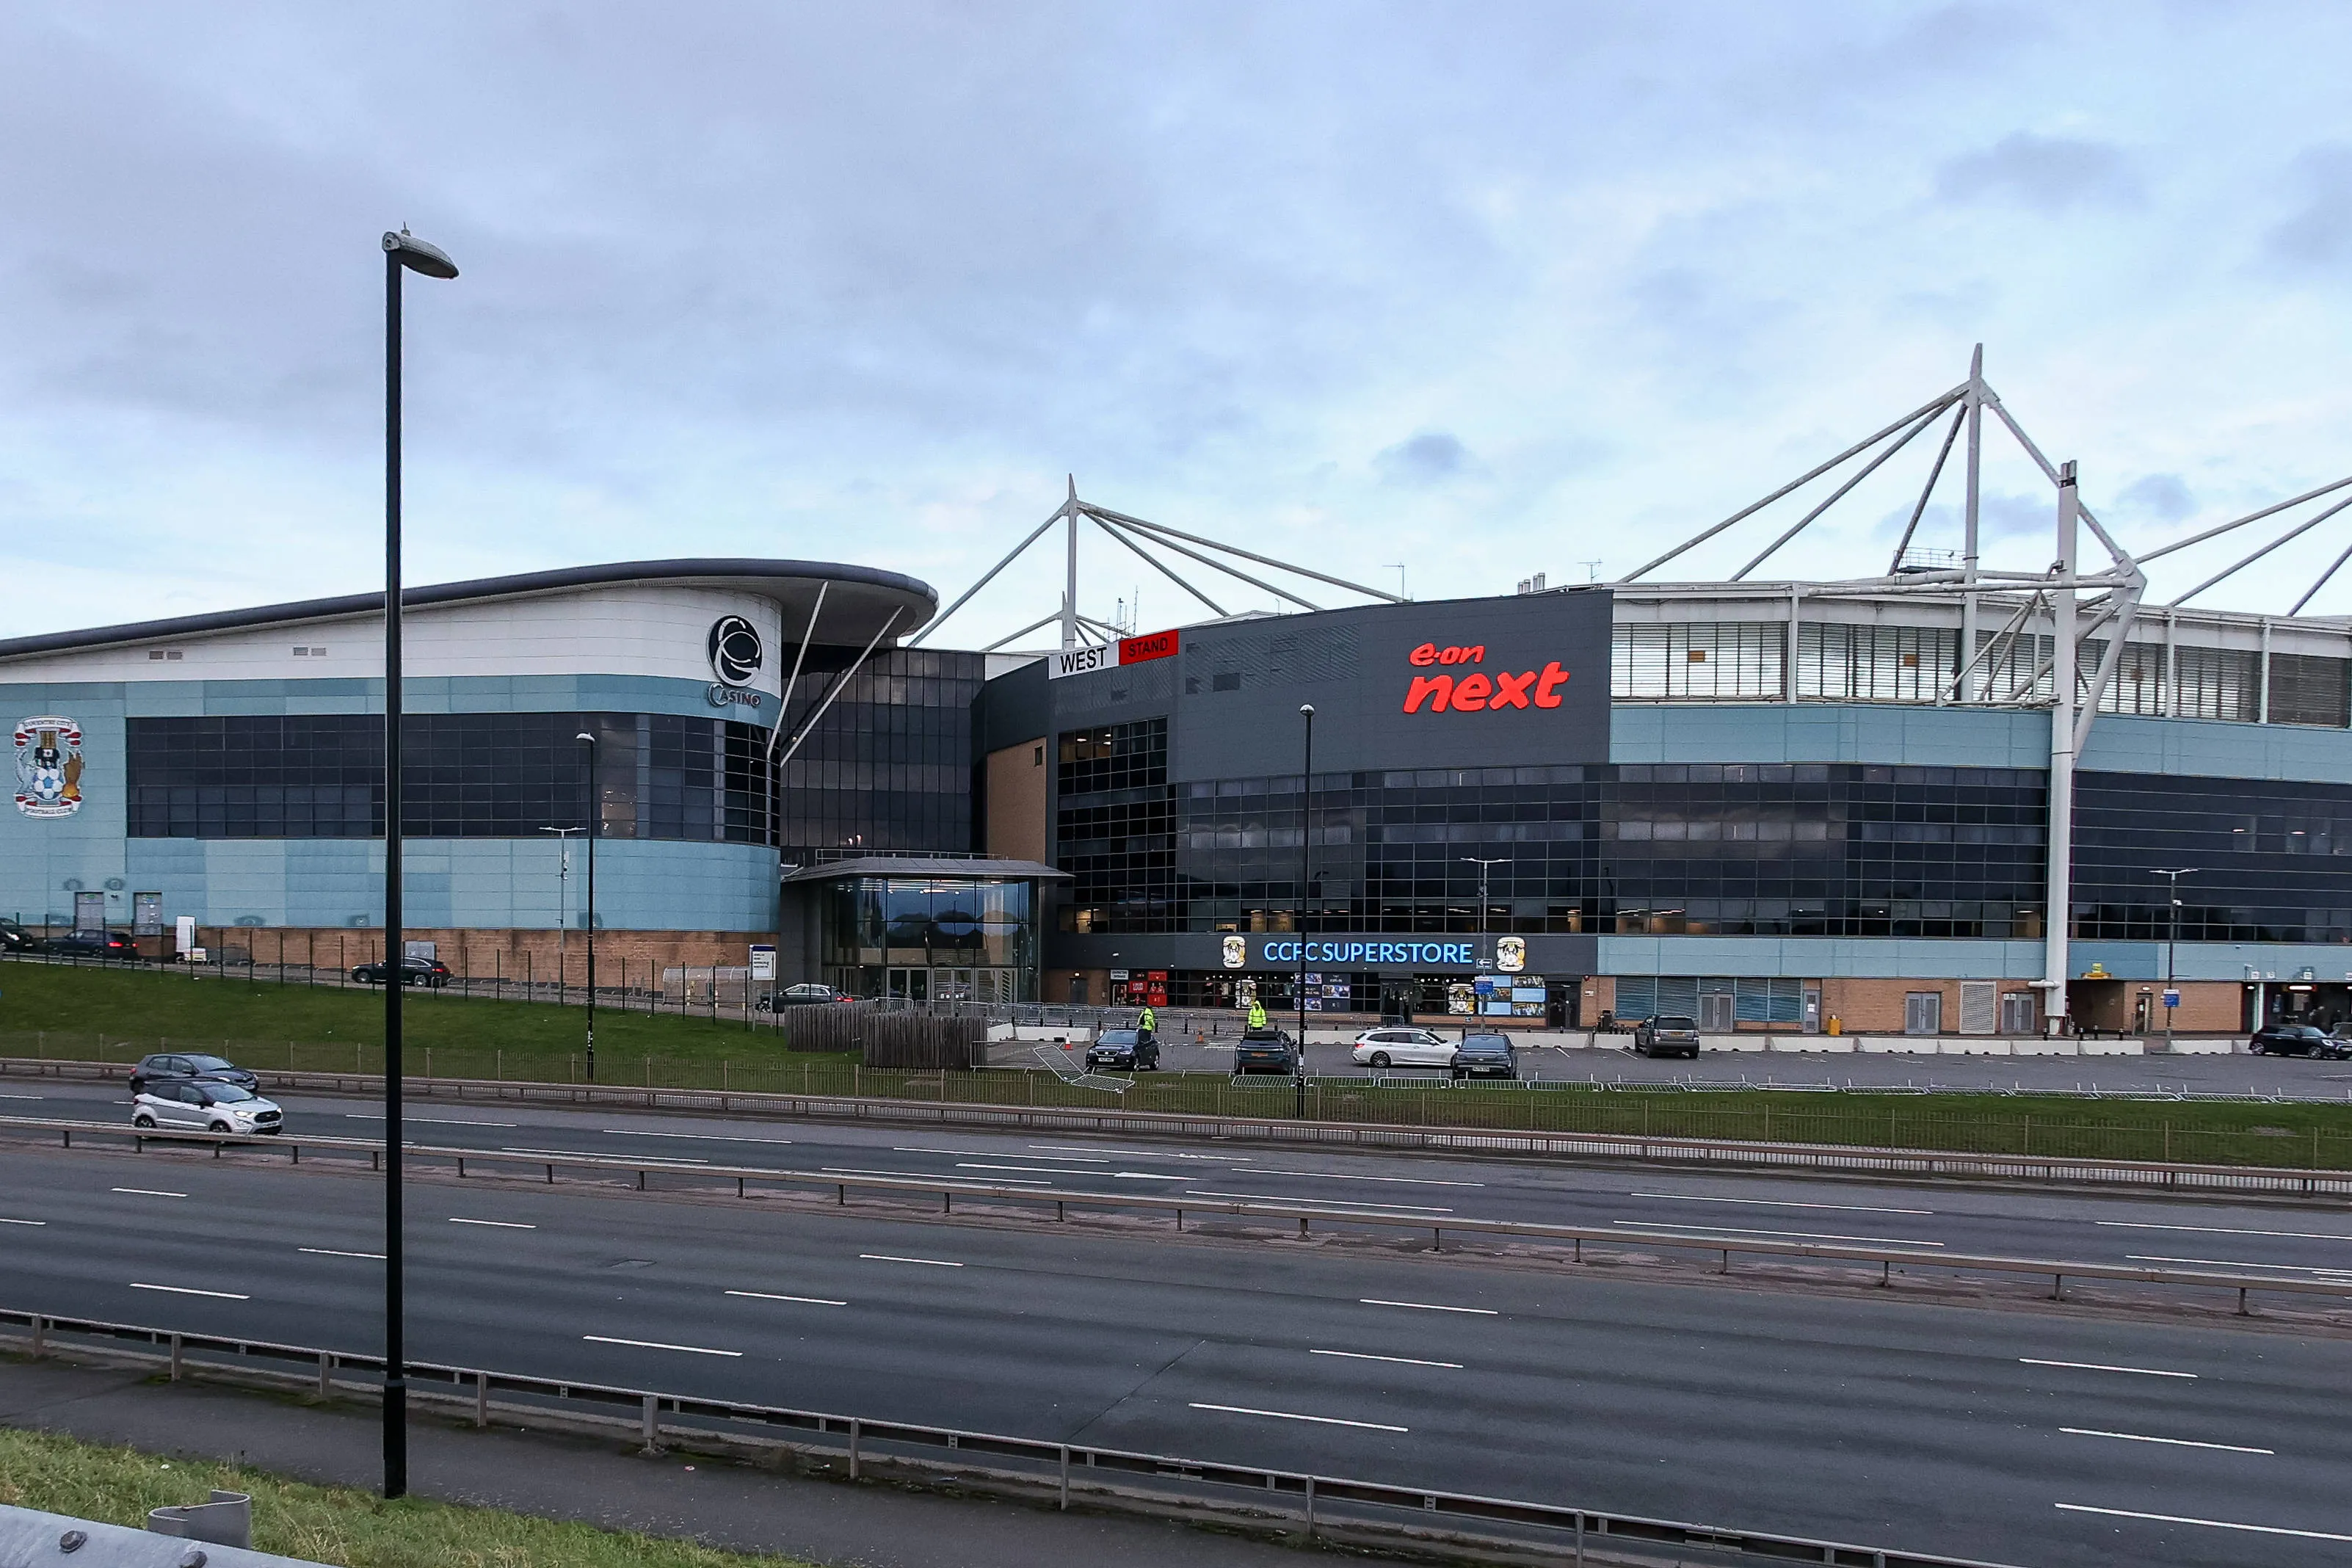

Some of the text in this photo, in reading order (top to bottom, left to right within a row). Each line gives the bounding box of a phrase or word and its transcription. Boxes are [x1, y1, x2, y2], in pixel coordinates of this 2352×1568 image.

[1060, 636, 1169, 674] WEST STAND
[1403, 661, 1570, 714] next
[1263, 942, 1473, 963] CCFC SUPERSTORE
